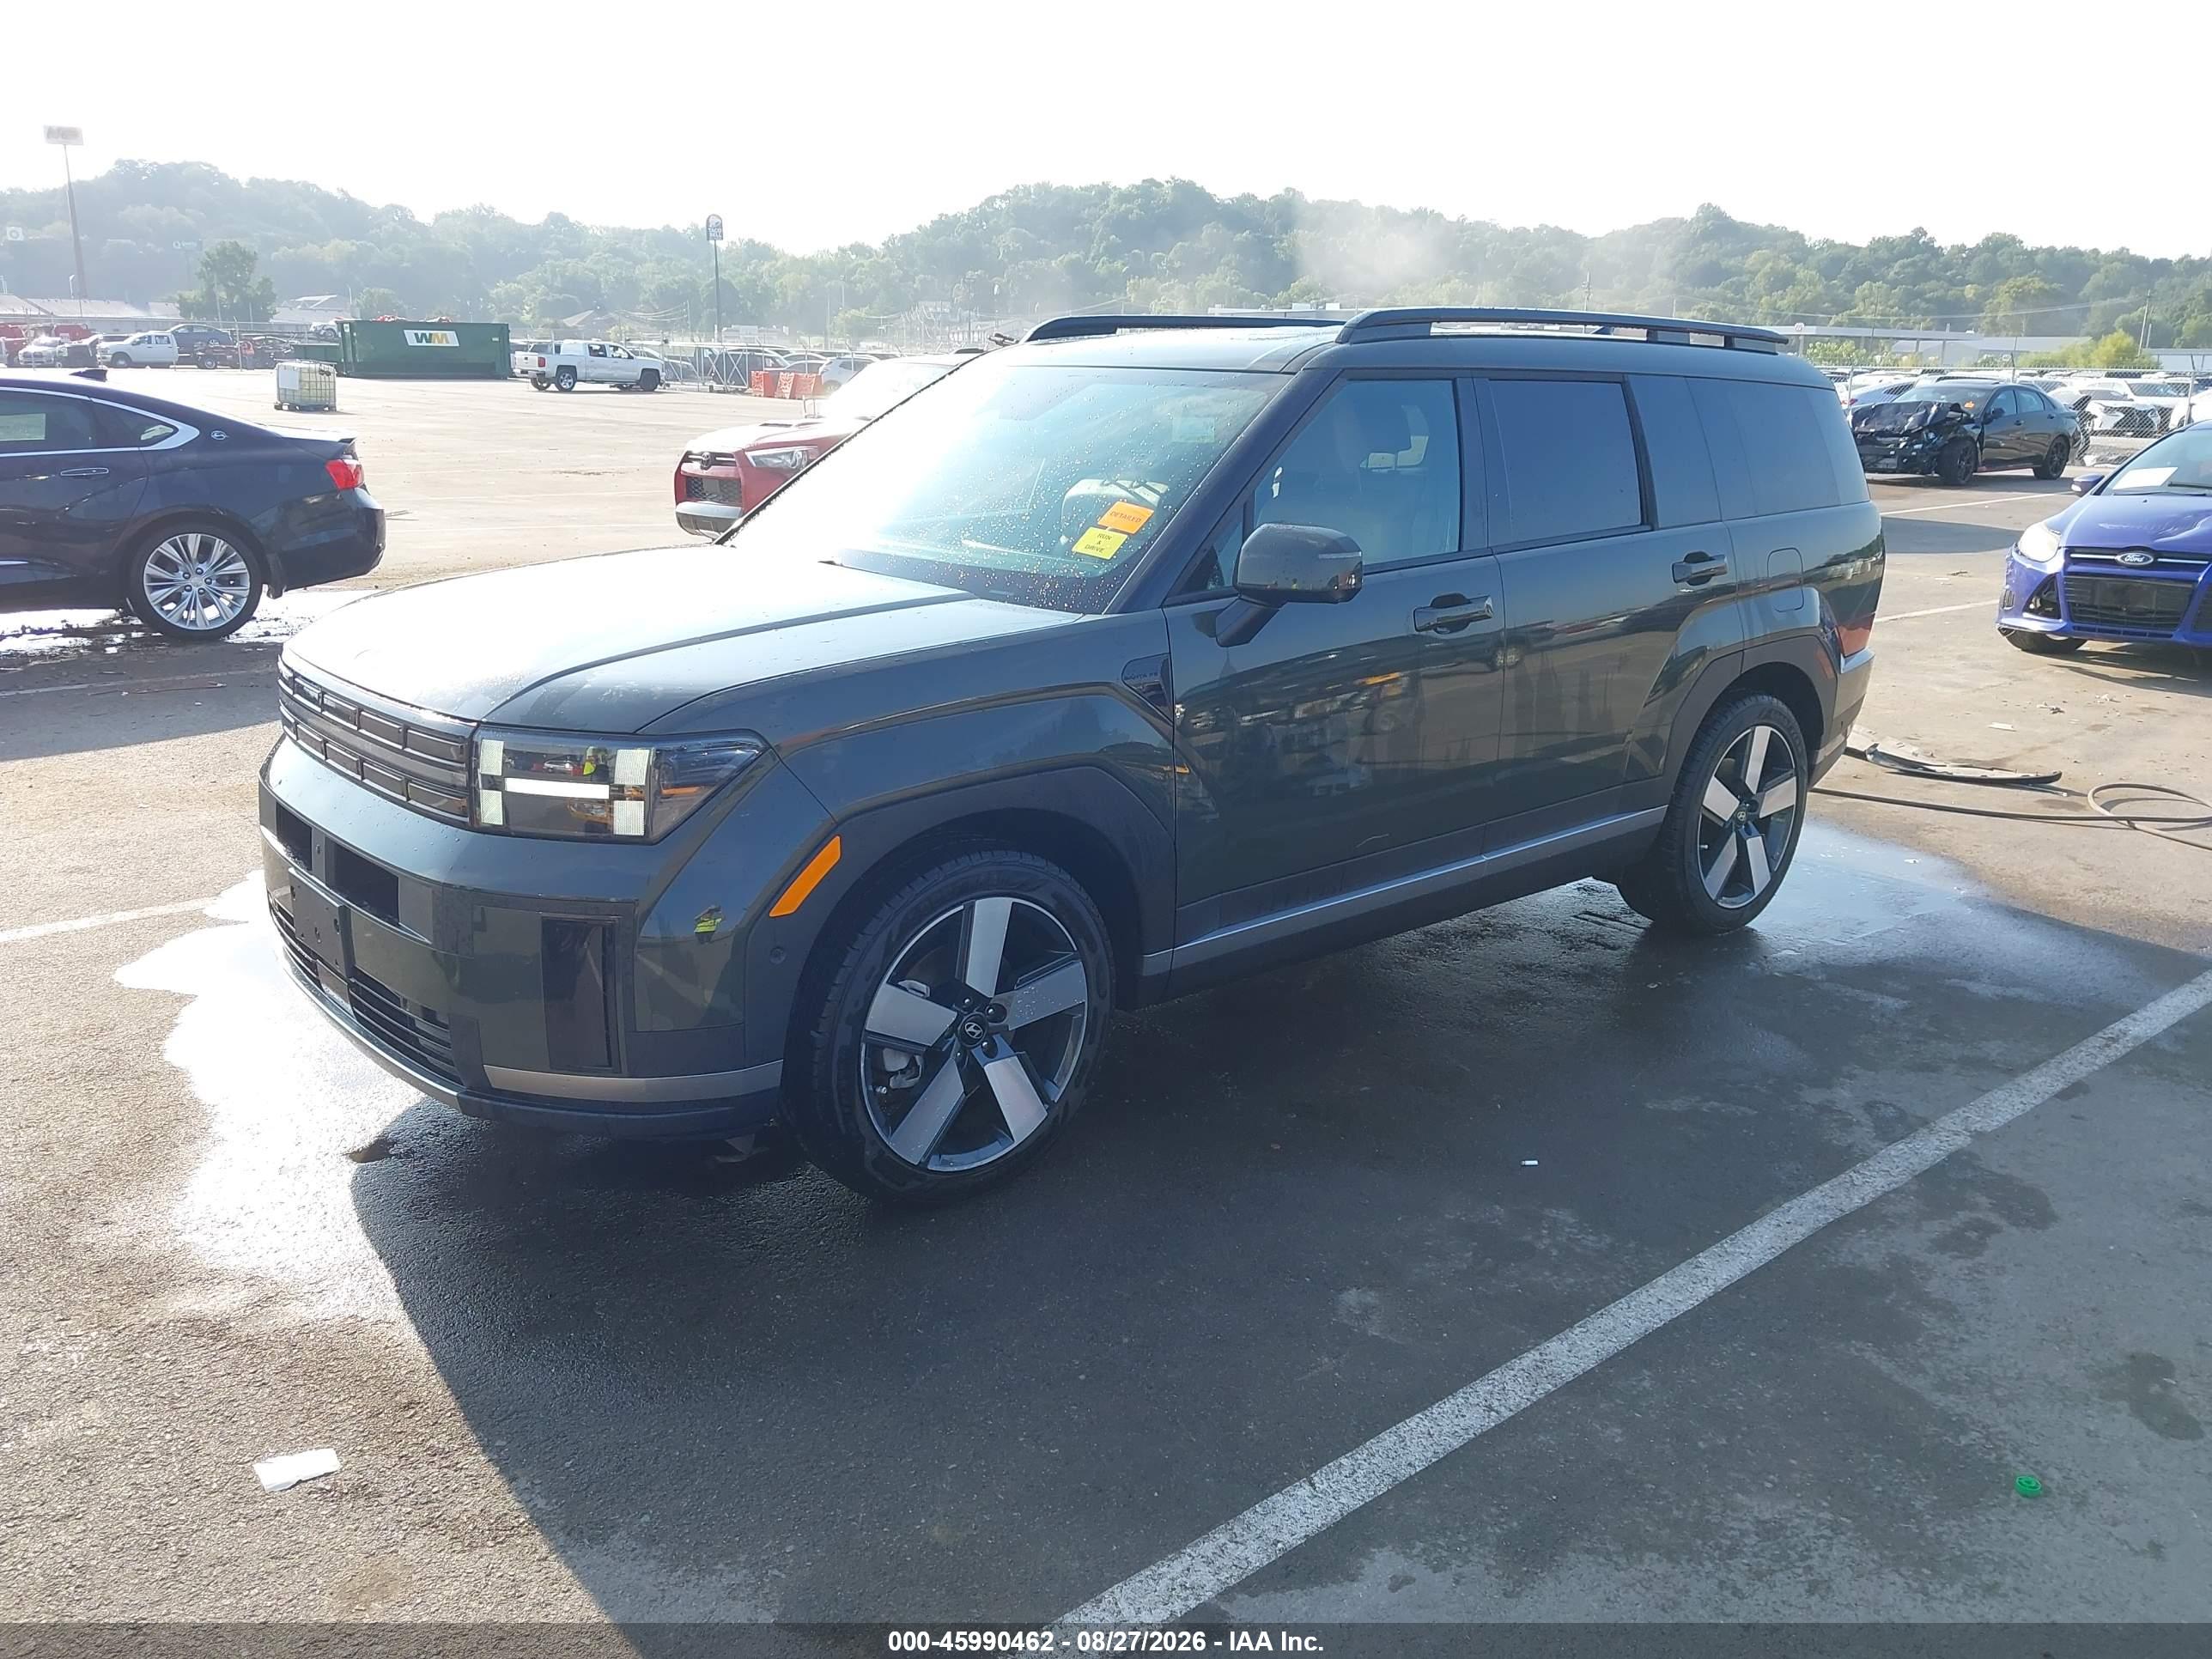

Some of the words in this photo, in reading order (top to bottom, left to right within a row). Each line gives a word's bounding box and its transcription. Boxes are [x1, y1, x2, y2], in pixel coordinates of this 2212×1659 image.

[414, 332, 450, 344] WM
[1109, 511, 1142, 523] DETAILED
[1085, 544, 1105, 553] DRIVE
[2124, 554, 2145, 562] Ford
